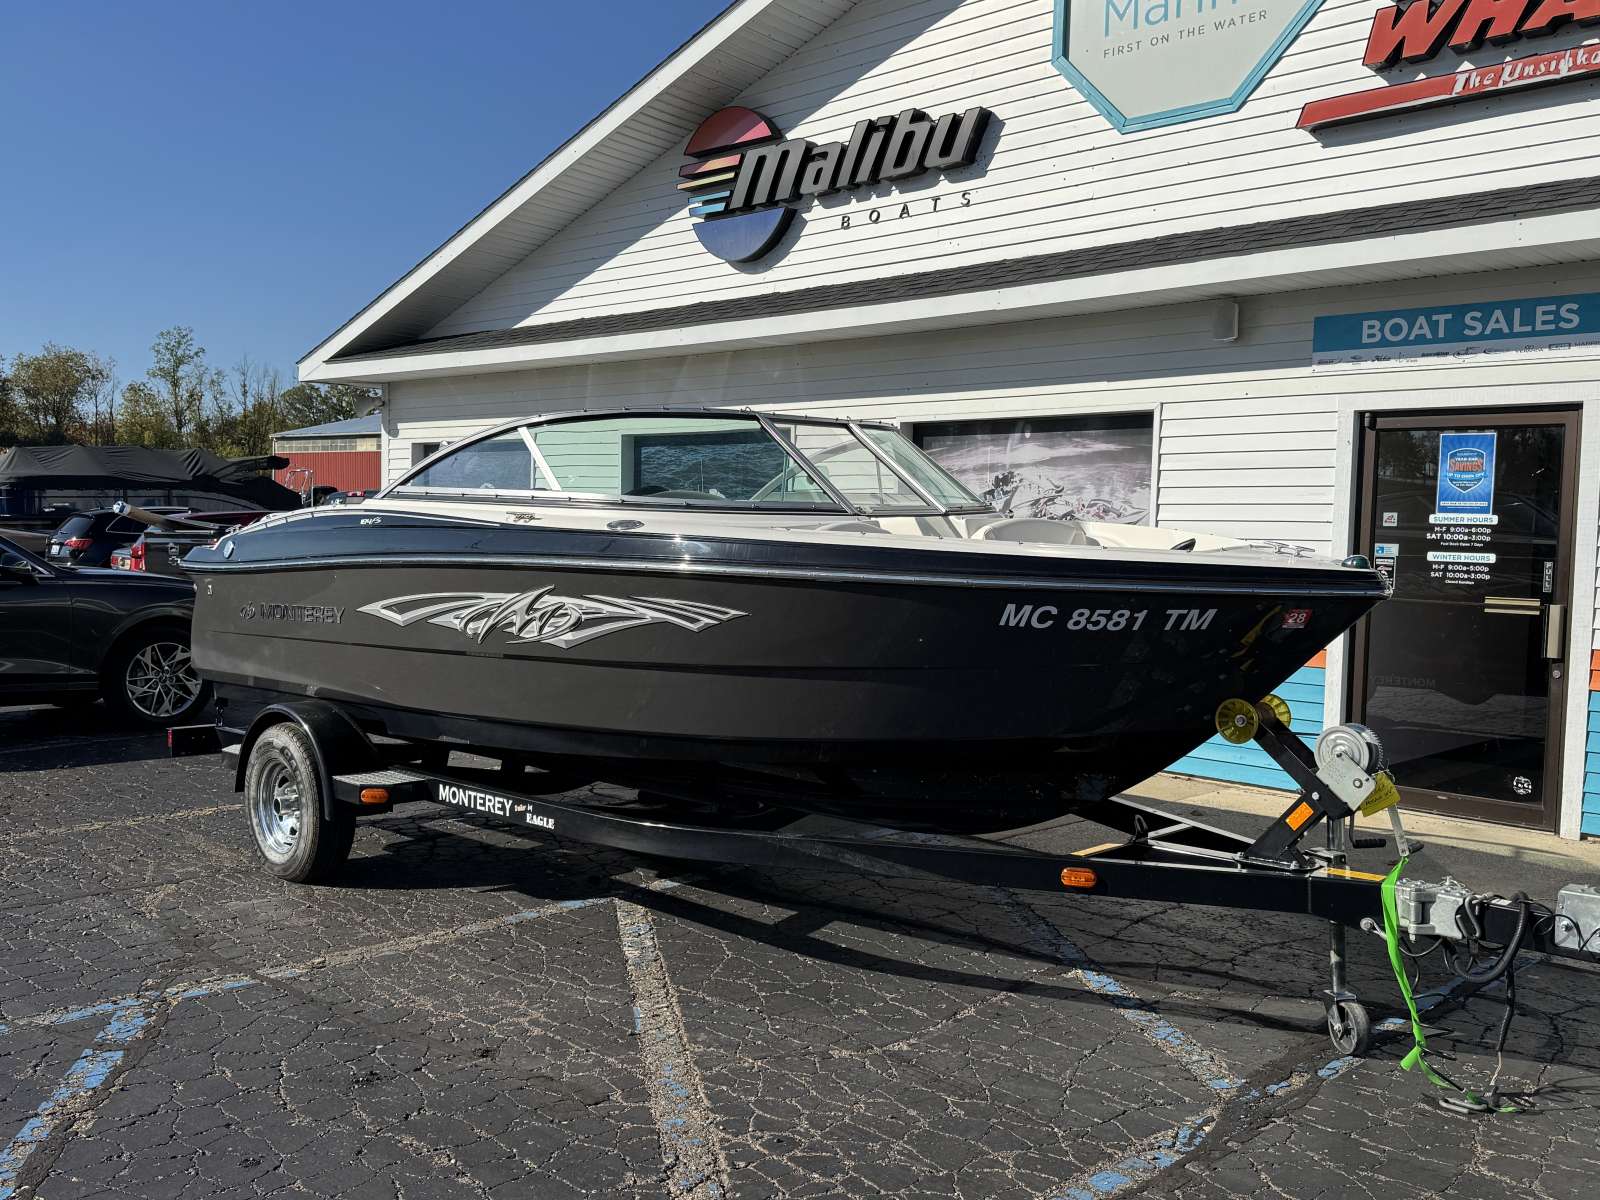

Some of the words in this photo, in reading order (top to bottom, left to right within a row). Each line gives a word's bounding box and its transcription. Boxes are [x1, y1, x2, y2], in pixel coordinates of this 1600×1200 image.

[1103, 40, 1143, 59] FIRST
[1150, 33, 1171, 47] ON
[1177, 25, 1206, 40] THE
[1213, 10, 1268, 32] WATER
[1451, 72, 1495, 97] The
[840, 192, 972, 230] BOATS
[1361, 313, 1453, 344] BOAT
[1463, 303, 1581, 337] SALES
[260, 603, 346, 624] MONTEREY
[999, 603, 1058, 629] MC
[1065, 608, 1149, 631] 8581
[1162, 608, 1218, 631] TM
[1288, 612, 1306, 624] 28
[438, 784, 513, 817] MONTEREY
[526, 812, 555, 830] EAGLE
